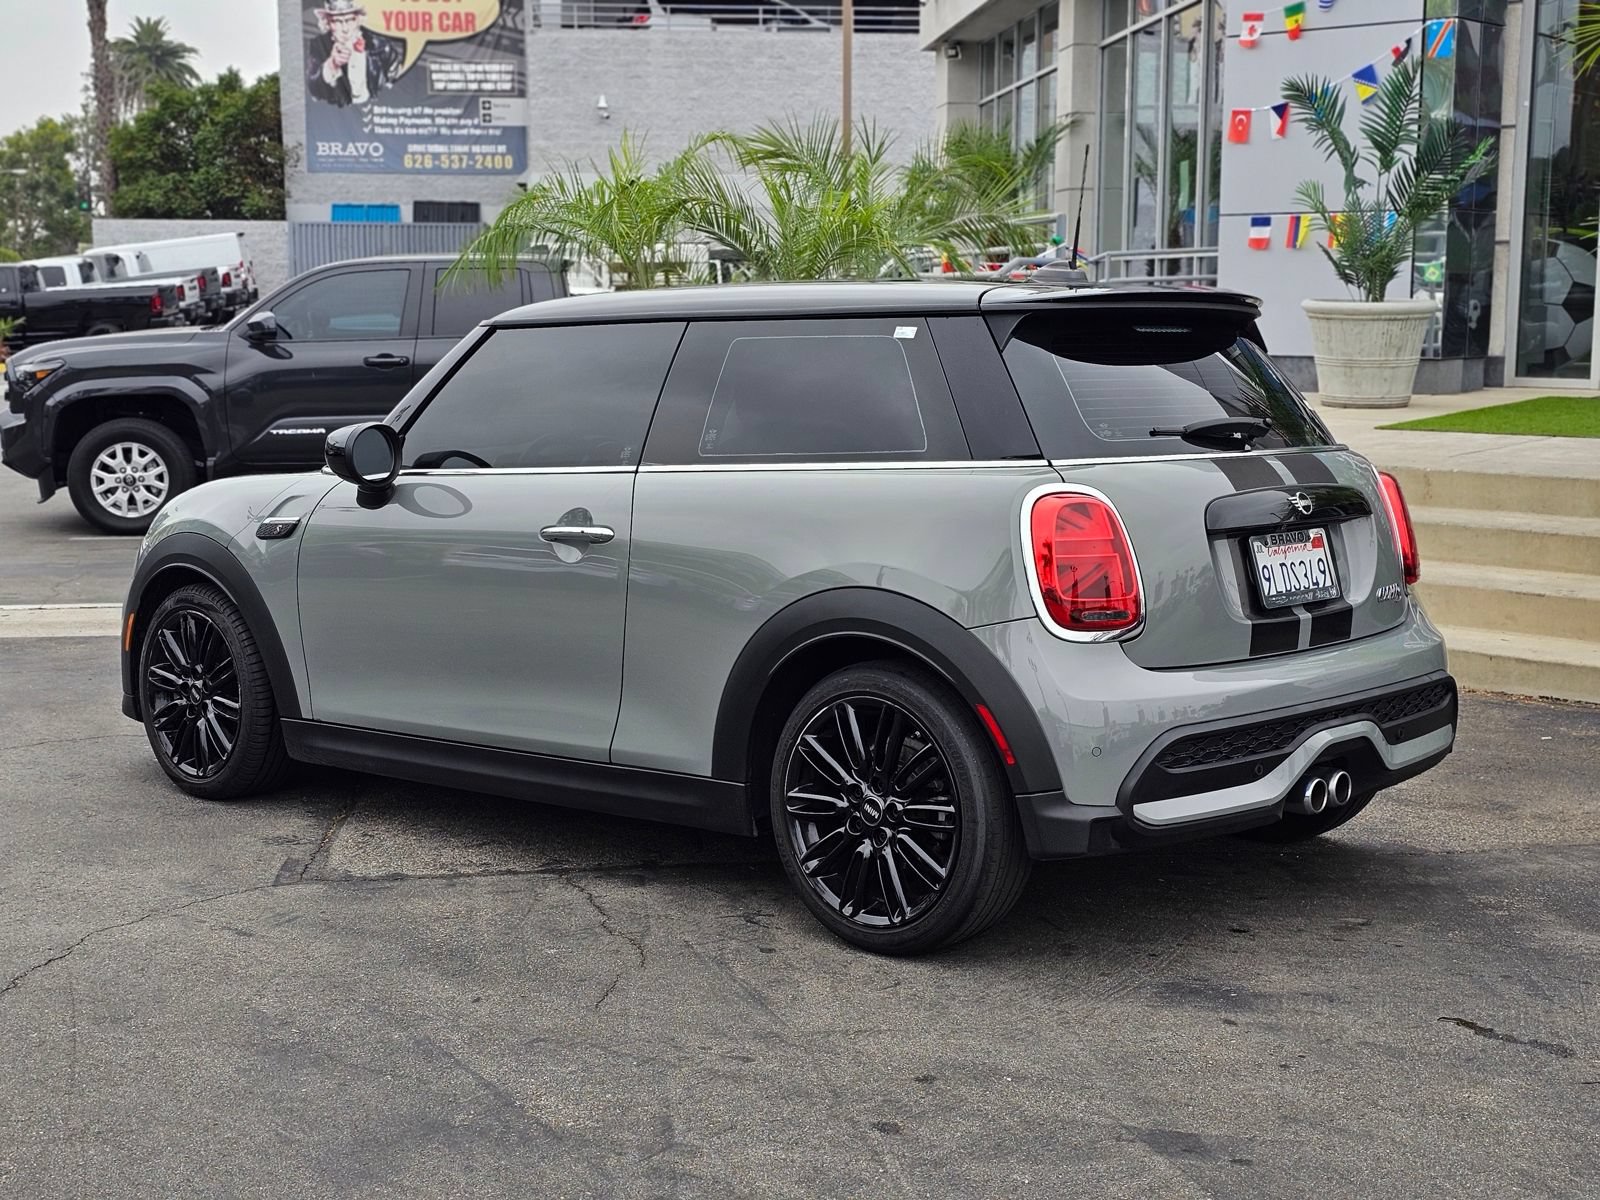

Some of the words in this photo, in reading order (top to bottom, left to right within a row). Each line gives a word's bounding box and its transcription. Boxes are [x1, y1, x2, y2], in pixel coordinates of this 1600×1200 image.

[382, 10, 433, 32] YOUR
[438, 11, 476, 32] CAR
[316, 142, 384, 157] BRAVO
[404, 154, 513, 169] 626-537-2400
[1270, 532, 1306, 545] BRAVO
[1261, 557, 1327, 596] 9LDS349
[863, 803, 880, 819] MINI
